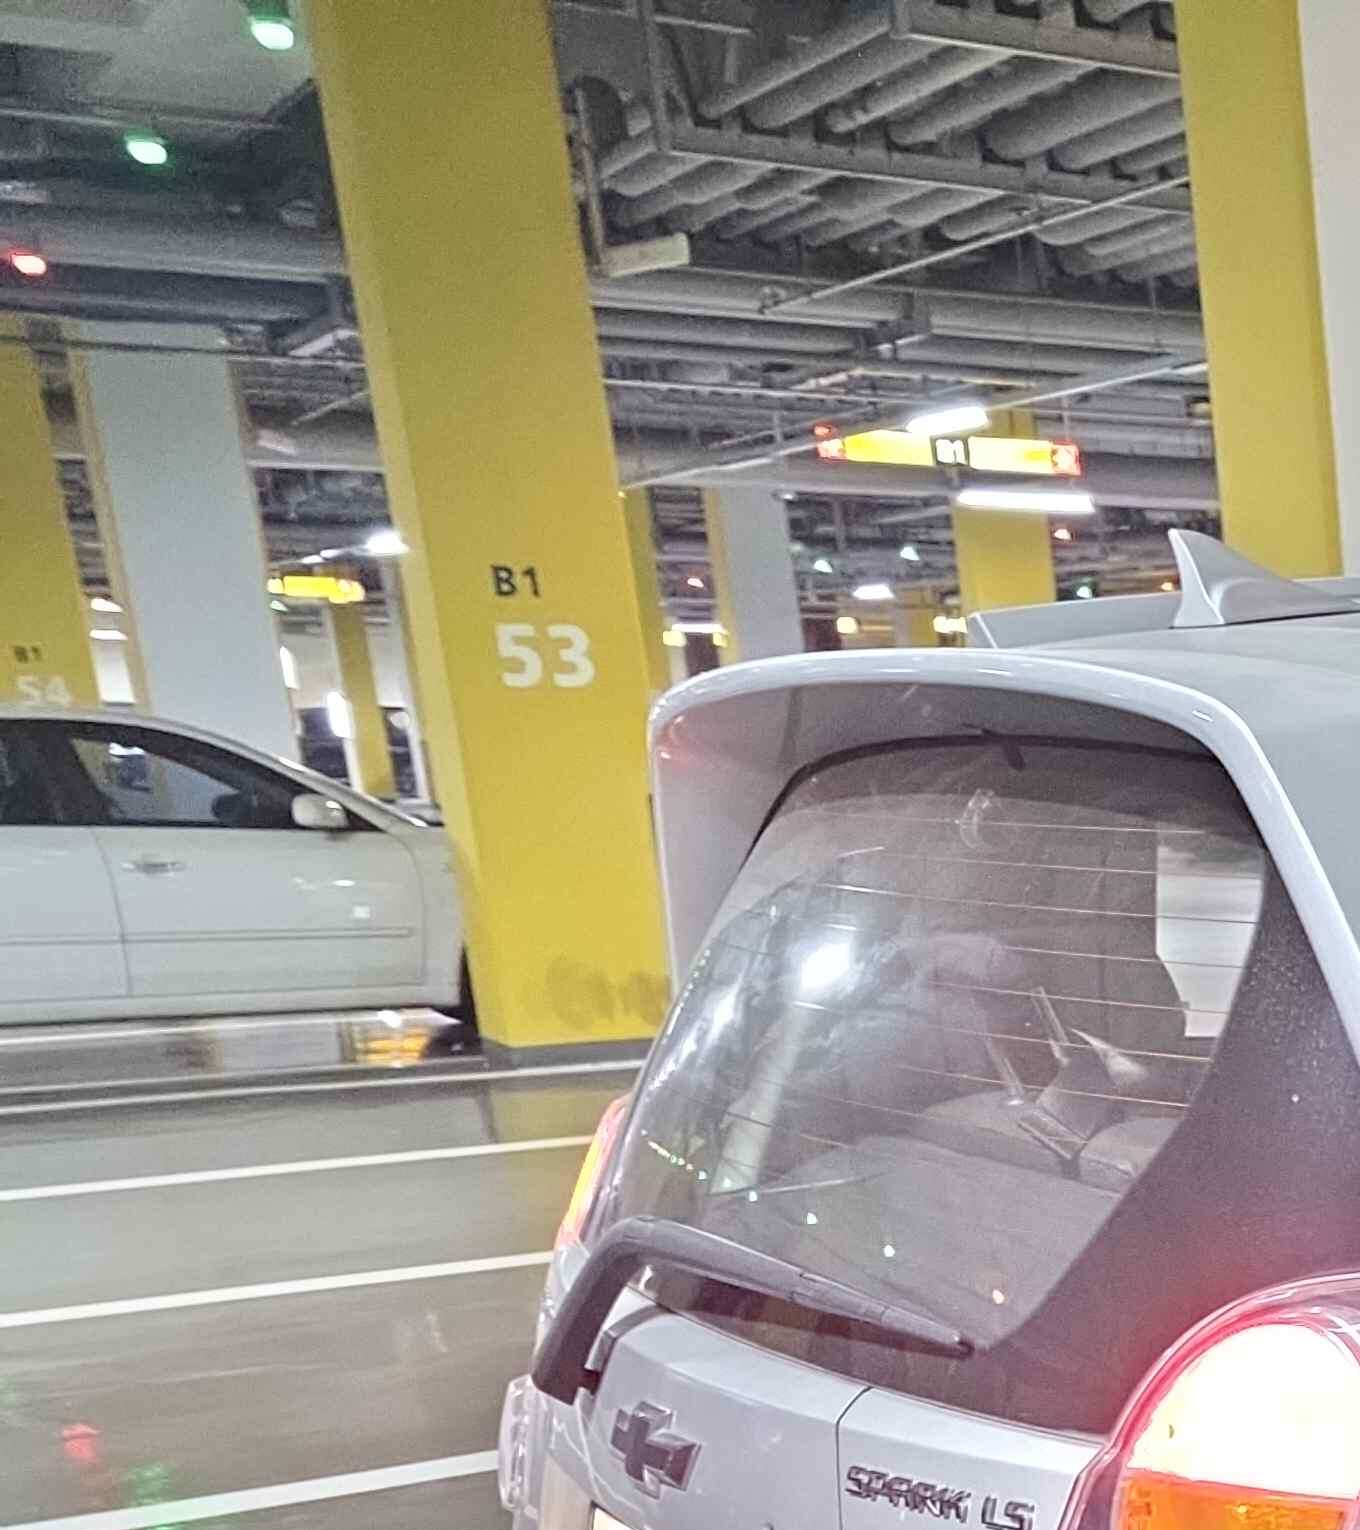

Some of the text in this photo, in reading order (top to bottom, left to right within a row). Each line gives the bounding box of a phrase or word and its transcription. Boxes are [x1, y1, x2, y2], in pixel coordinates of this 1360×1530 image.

[490, 564, 541, 598] B1
[496, 622, 596, 688] 53
[845, 1465, 971, 1524] SPARK
